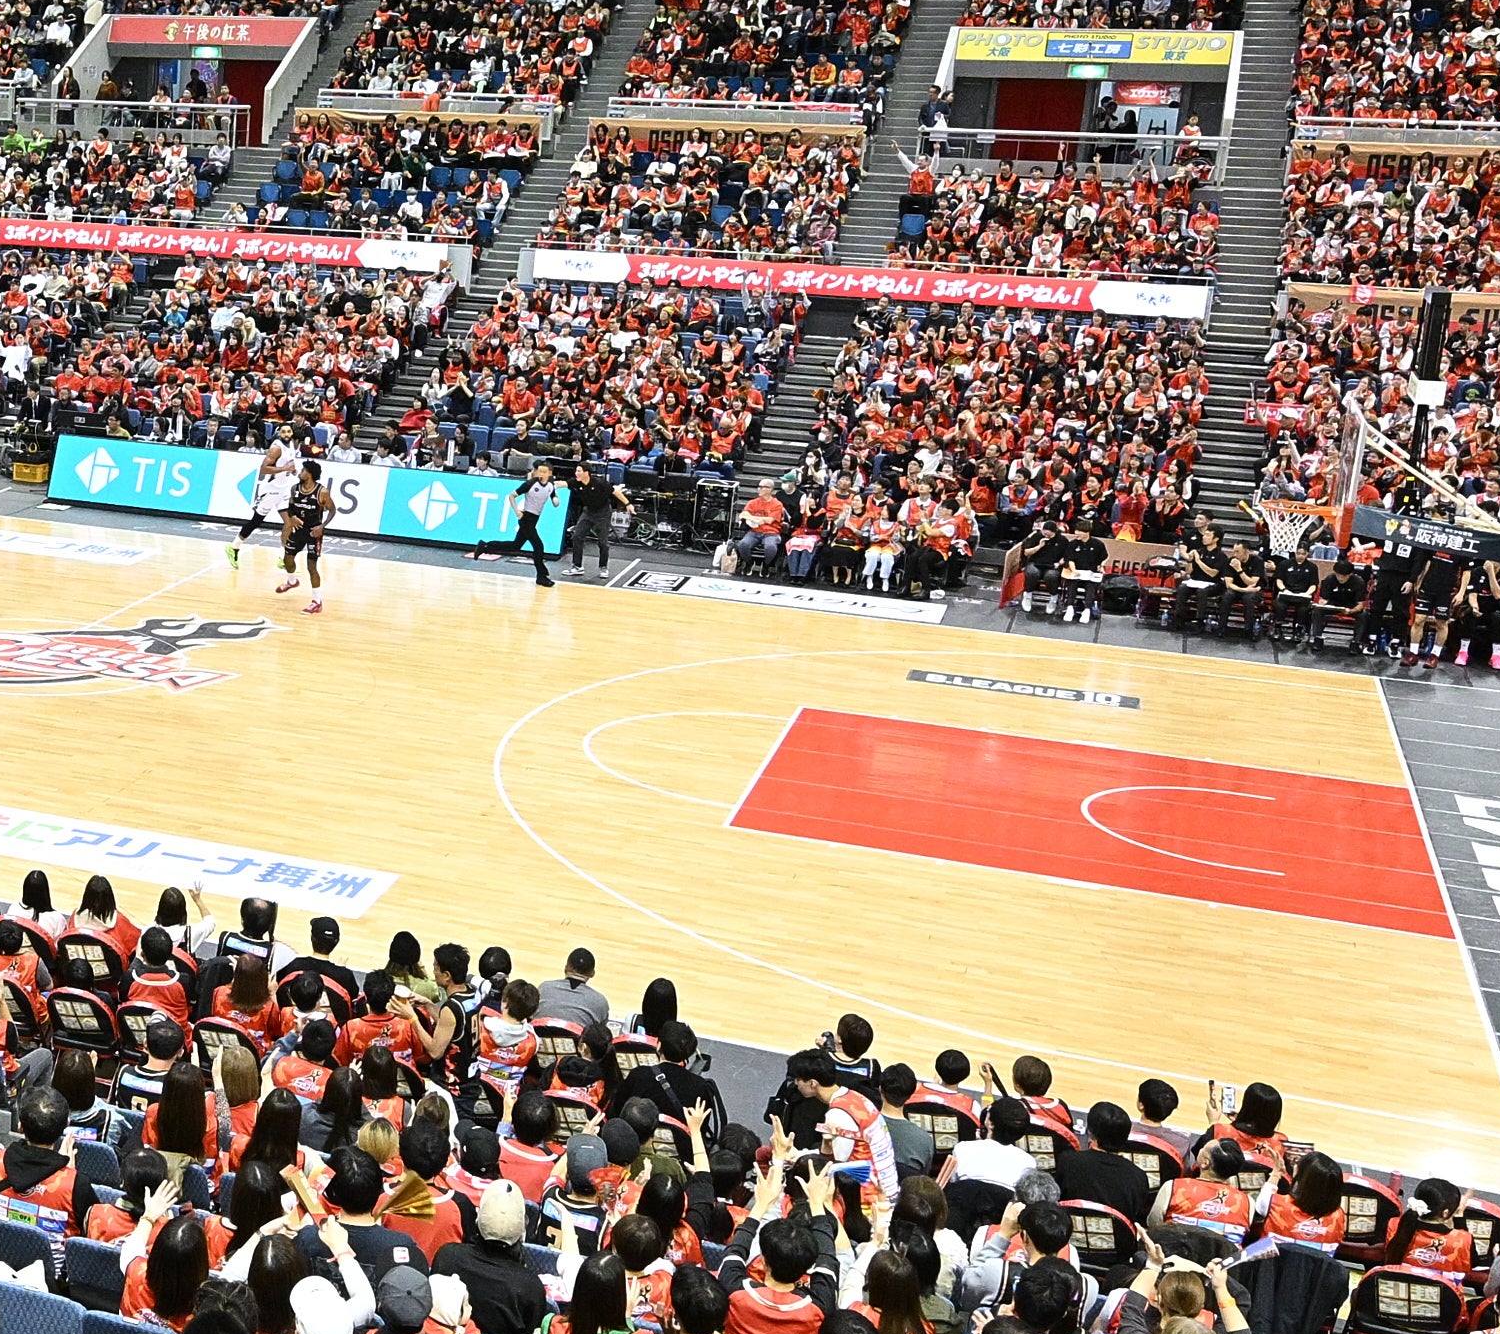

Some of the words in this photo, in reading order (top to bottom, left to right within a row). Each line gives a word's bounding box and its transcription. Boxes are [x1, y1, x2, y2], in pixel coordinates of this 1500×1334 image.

[182, 21, 249, 44] 午後の紅茶
[960, 32, 1044, 47] PHOTO
[1136, 37, 1228, 51] STUDIO
[986, 47, 1011, 58] 大阪
[1162, 50, 1188, 61] 東京
[133, 457, 192, 498] TIS
[1415, 528, 1480, 555] 阪神建工
[925, 672, 1075, 704] B.LEAGUE
